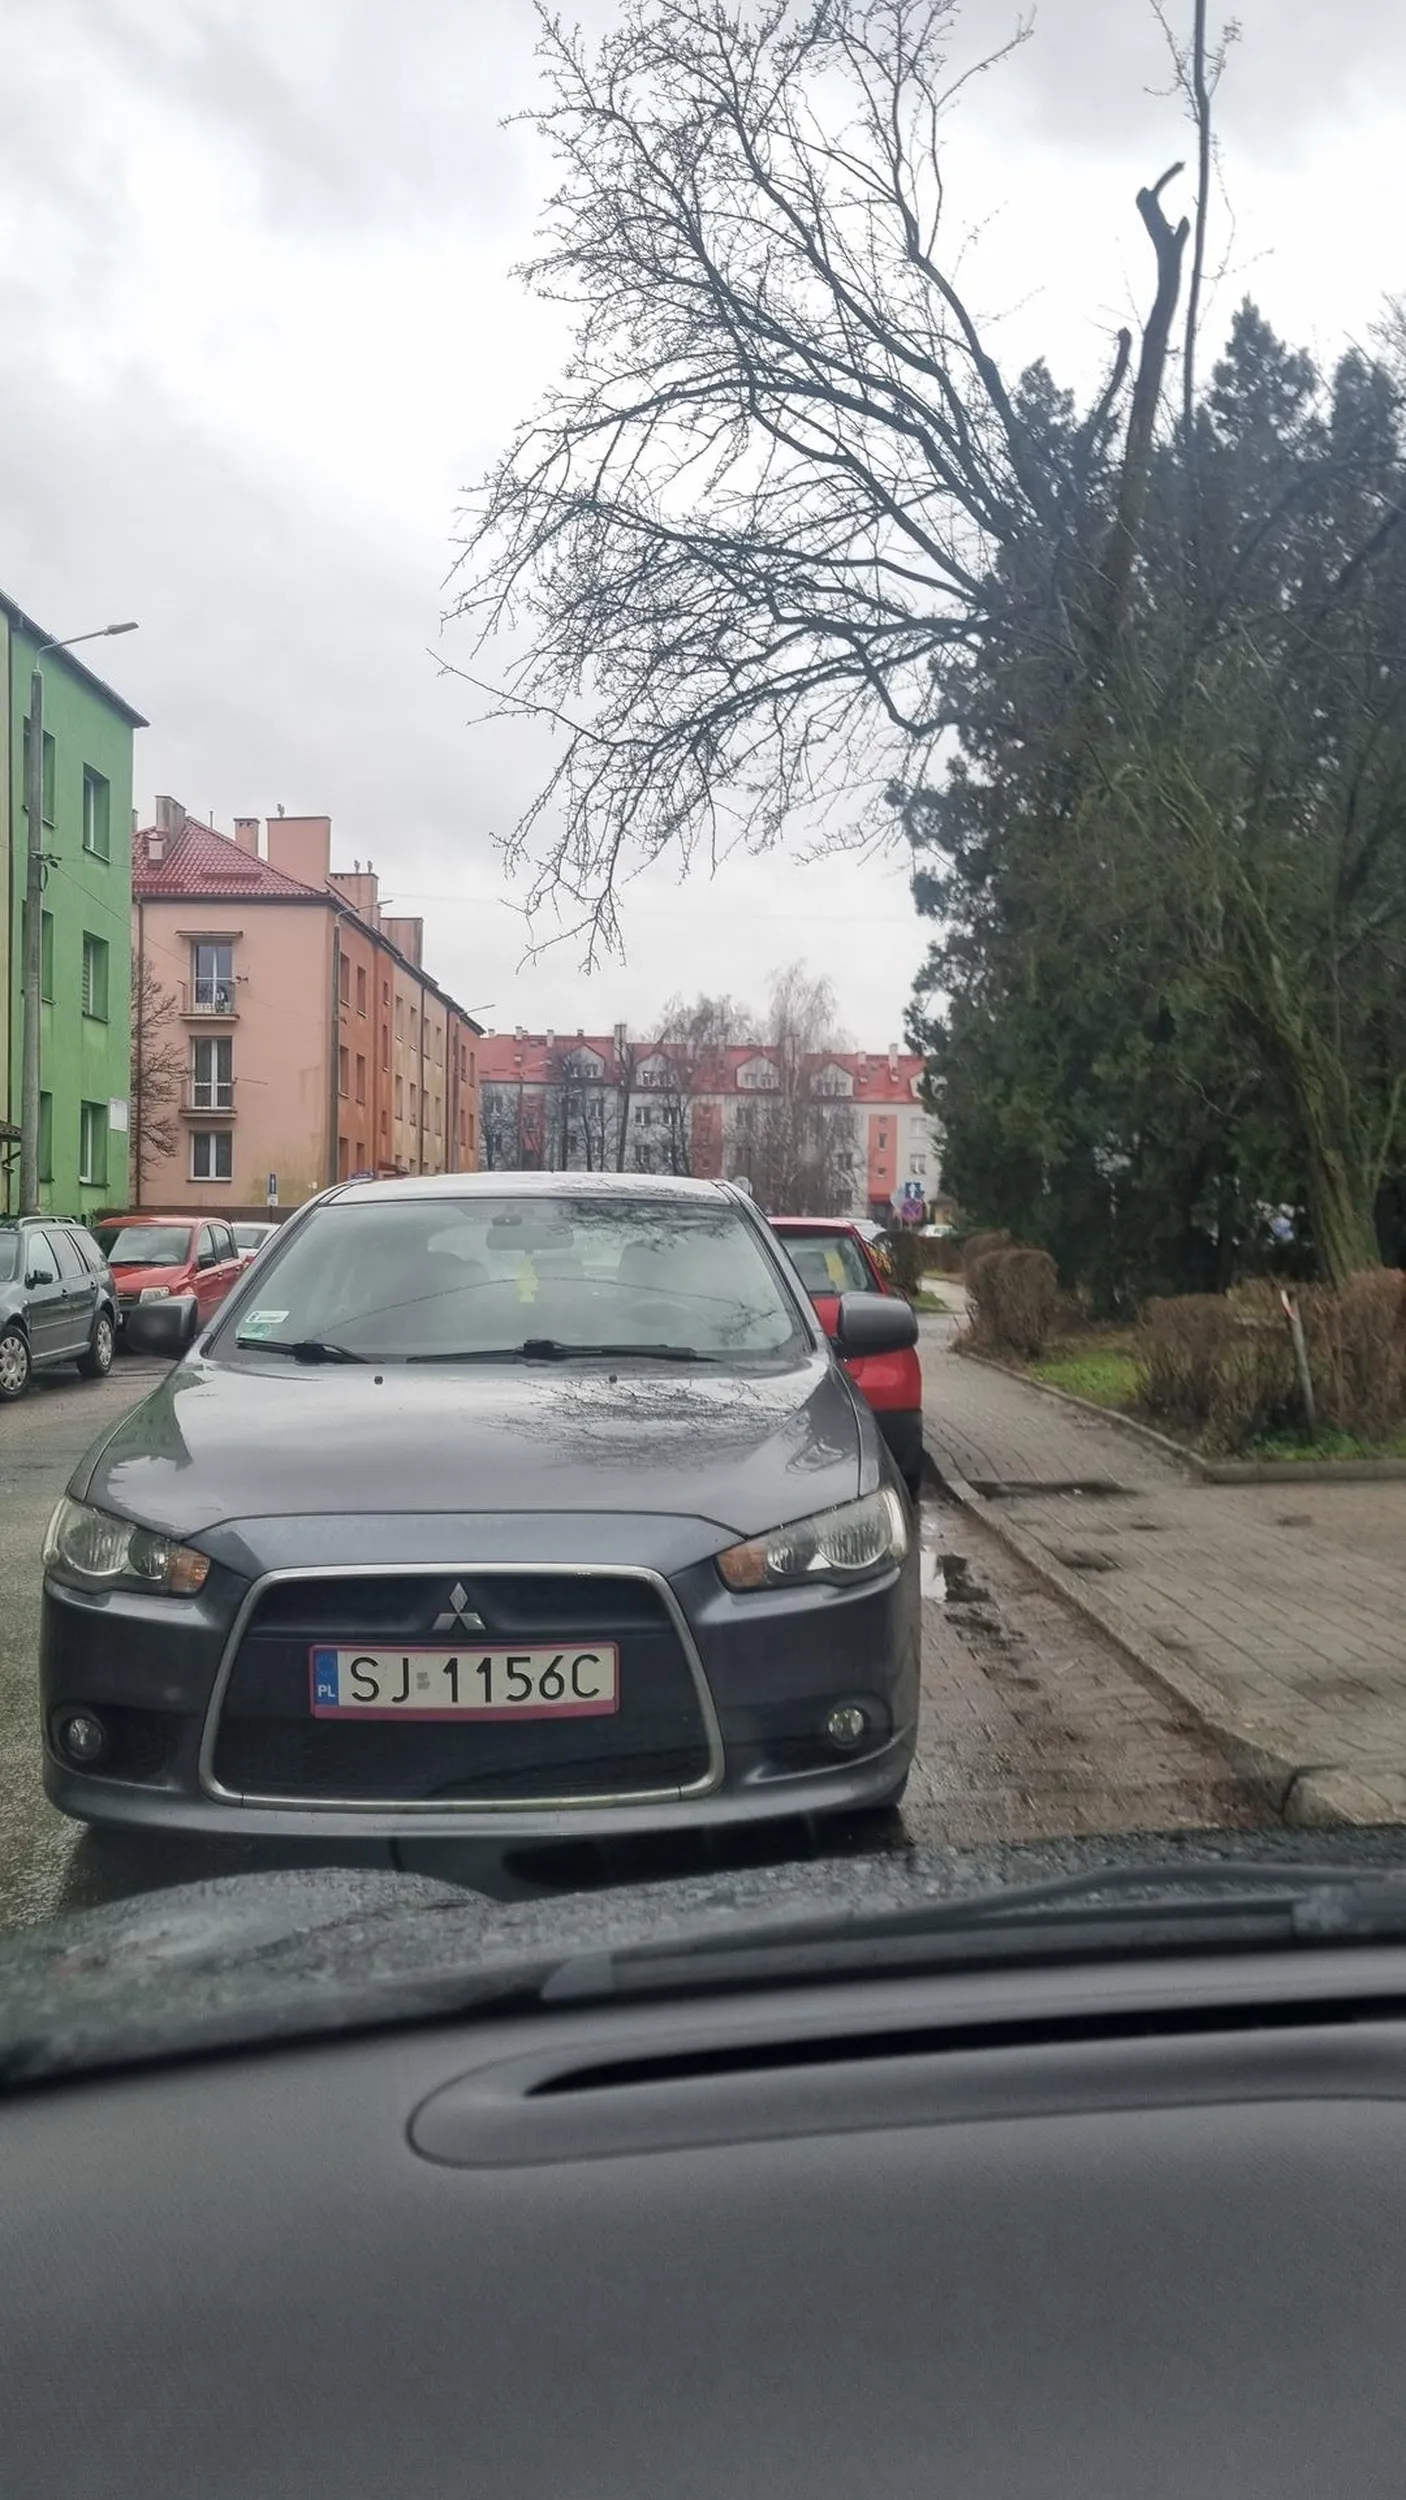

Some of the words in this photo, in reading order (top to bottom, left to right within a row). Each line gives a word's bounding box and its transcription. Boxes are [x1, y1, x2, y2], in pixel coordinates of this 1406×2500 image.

[317, 1684, 336, 1698] PL
[350, 1656, 410, 1703] SJ
[442, 1653, 601, 1703] 1156C
